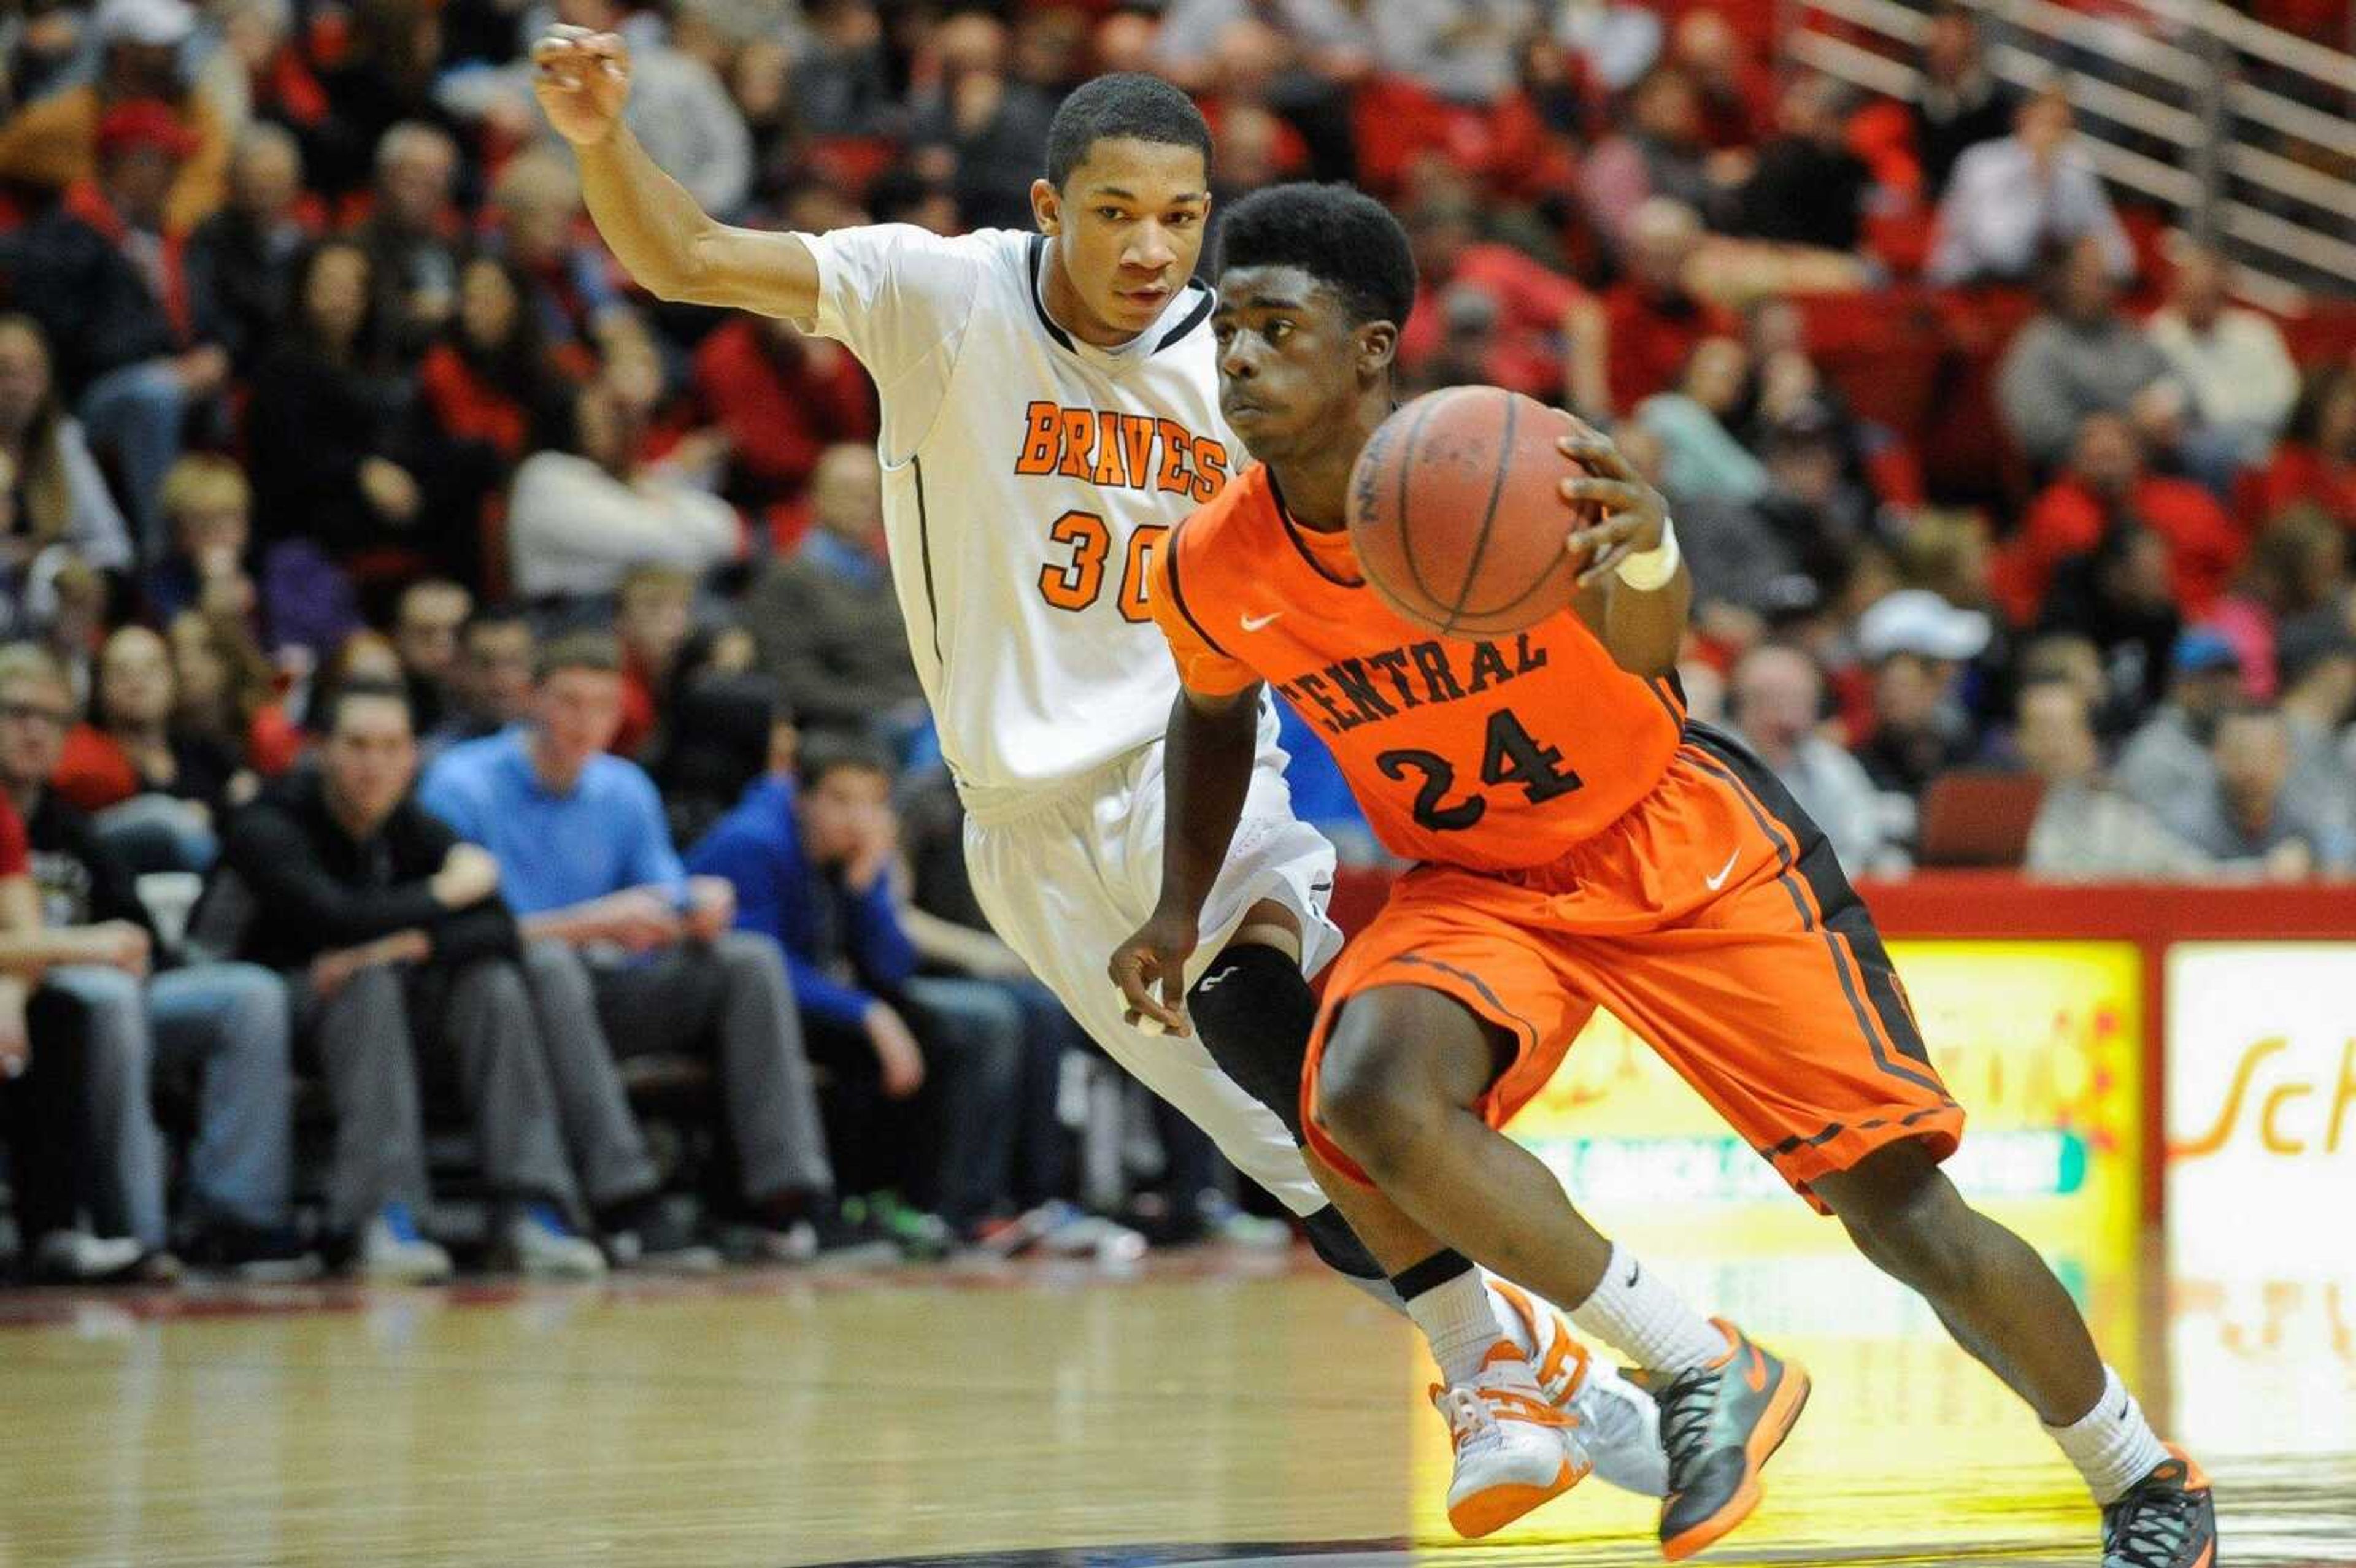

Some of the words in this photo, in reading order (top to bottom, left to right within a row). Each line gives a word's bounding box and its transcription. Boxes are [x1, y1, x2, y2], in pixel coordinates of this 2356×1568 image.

[1014, 401, 1227, 504] BRAVES
[1037, 509, 1169, 623] 30
[1376, 707, 1584, 832] 24
